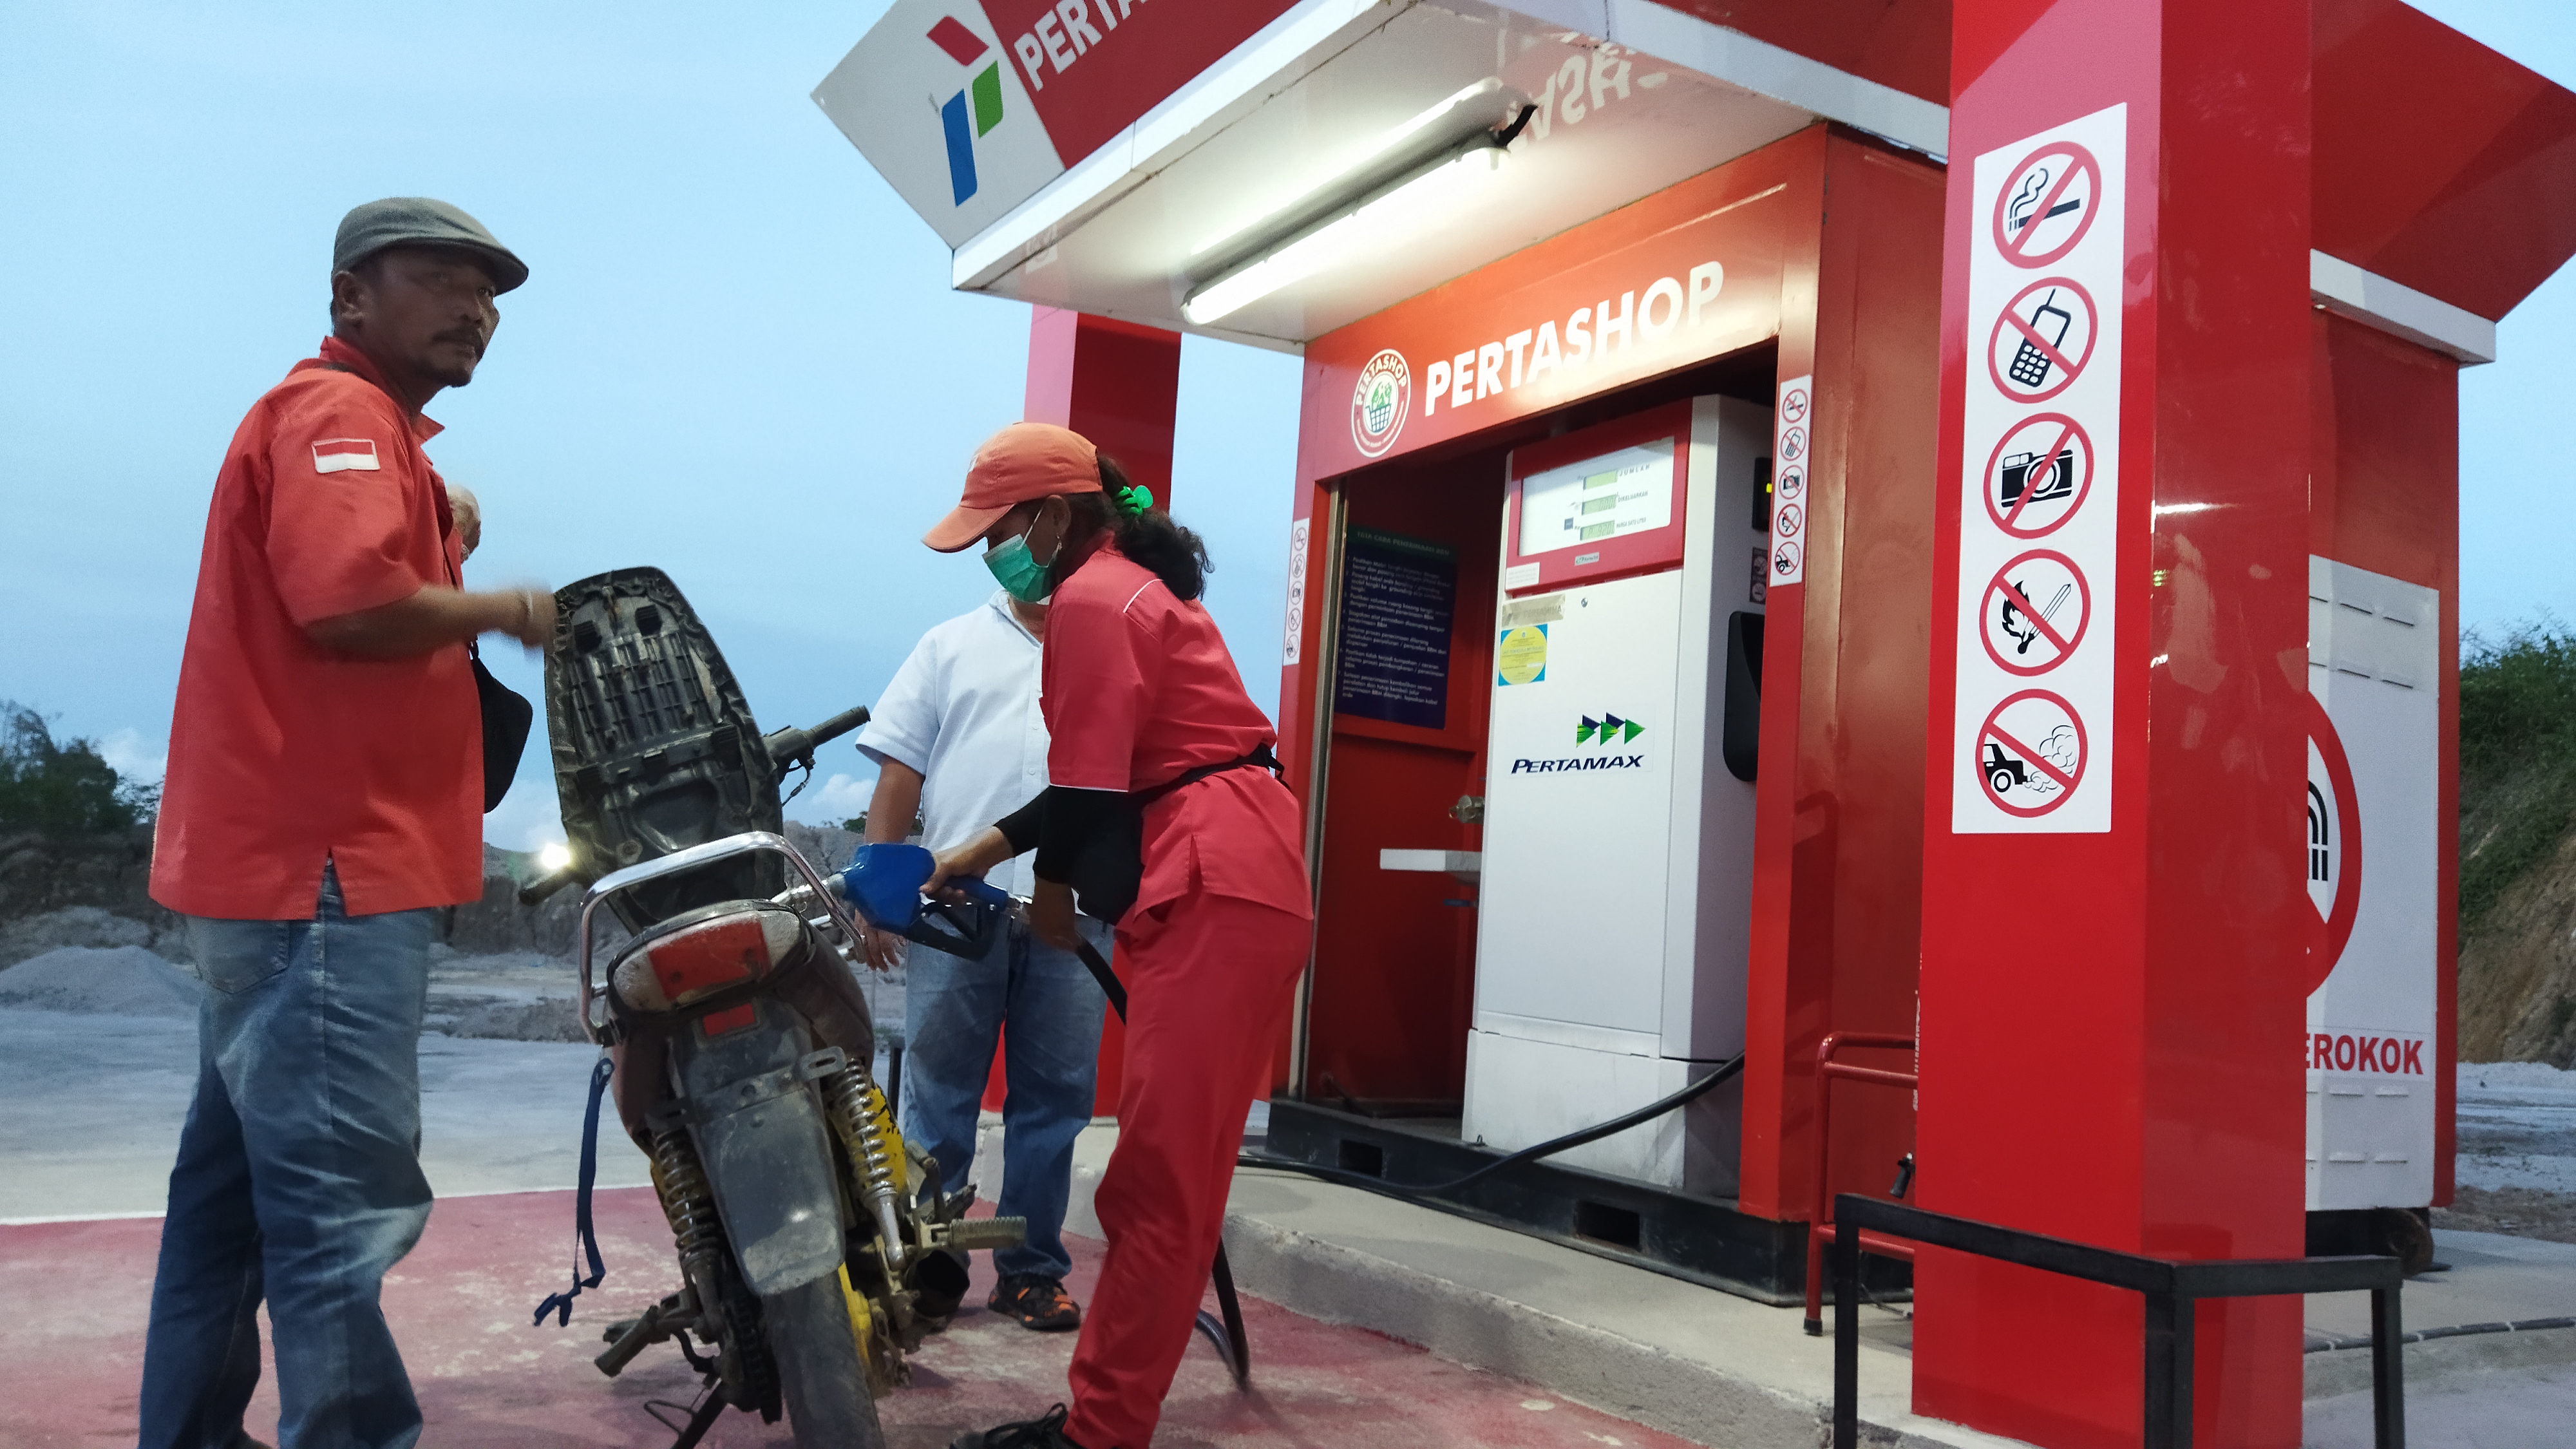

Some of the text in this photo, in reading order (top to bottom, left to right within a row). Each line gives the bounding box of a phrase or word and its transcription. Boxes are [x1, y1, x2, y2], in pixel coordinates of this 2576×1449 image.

[1425, 261, 1724, 417] PERTASHOP
[1355, 355, 1407, 406] PERTASHOP
[1619, 464, 1650, 477] JUMLAH
[1511, 755, 1645, 774] PERTAMAX
[2306, 1034, 2423, 1075] ROKOK
